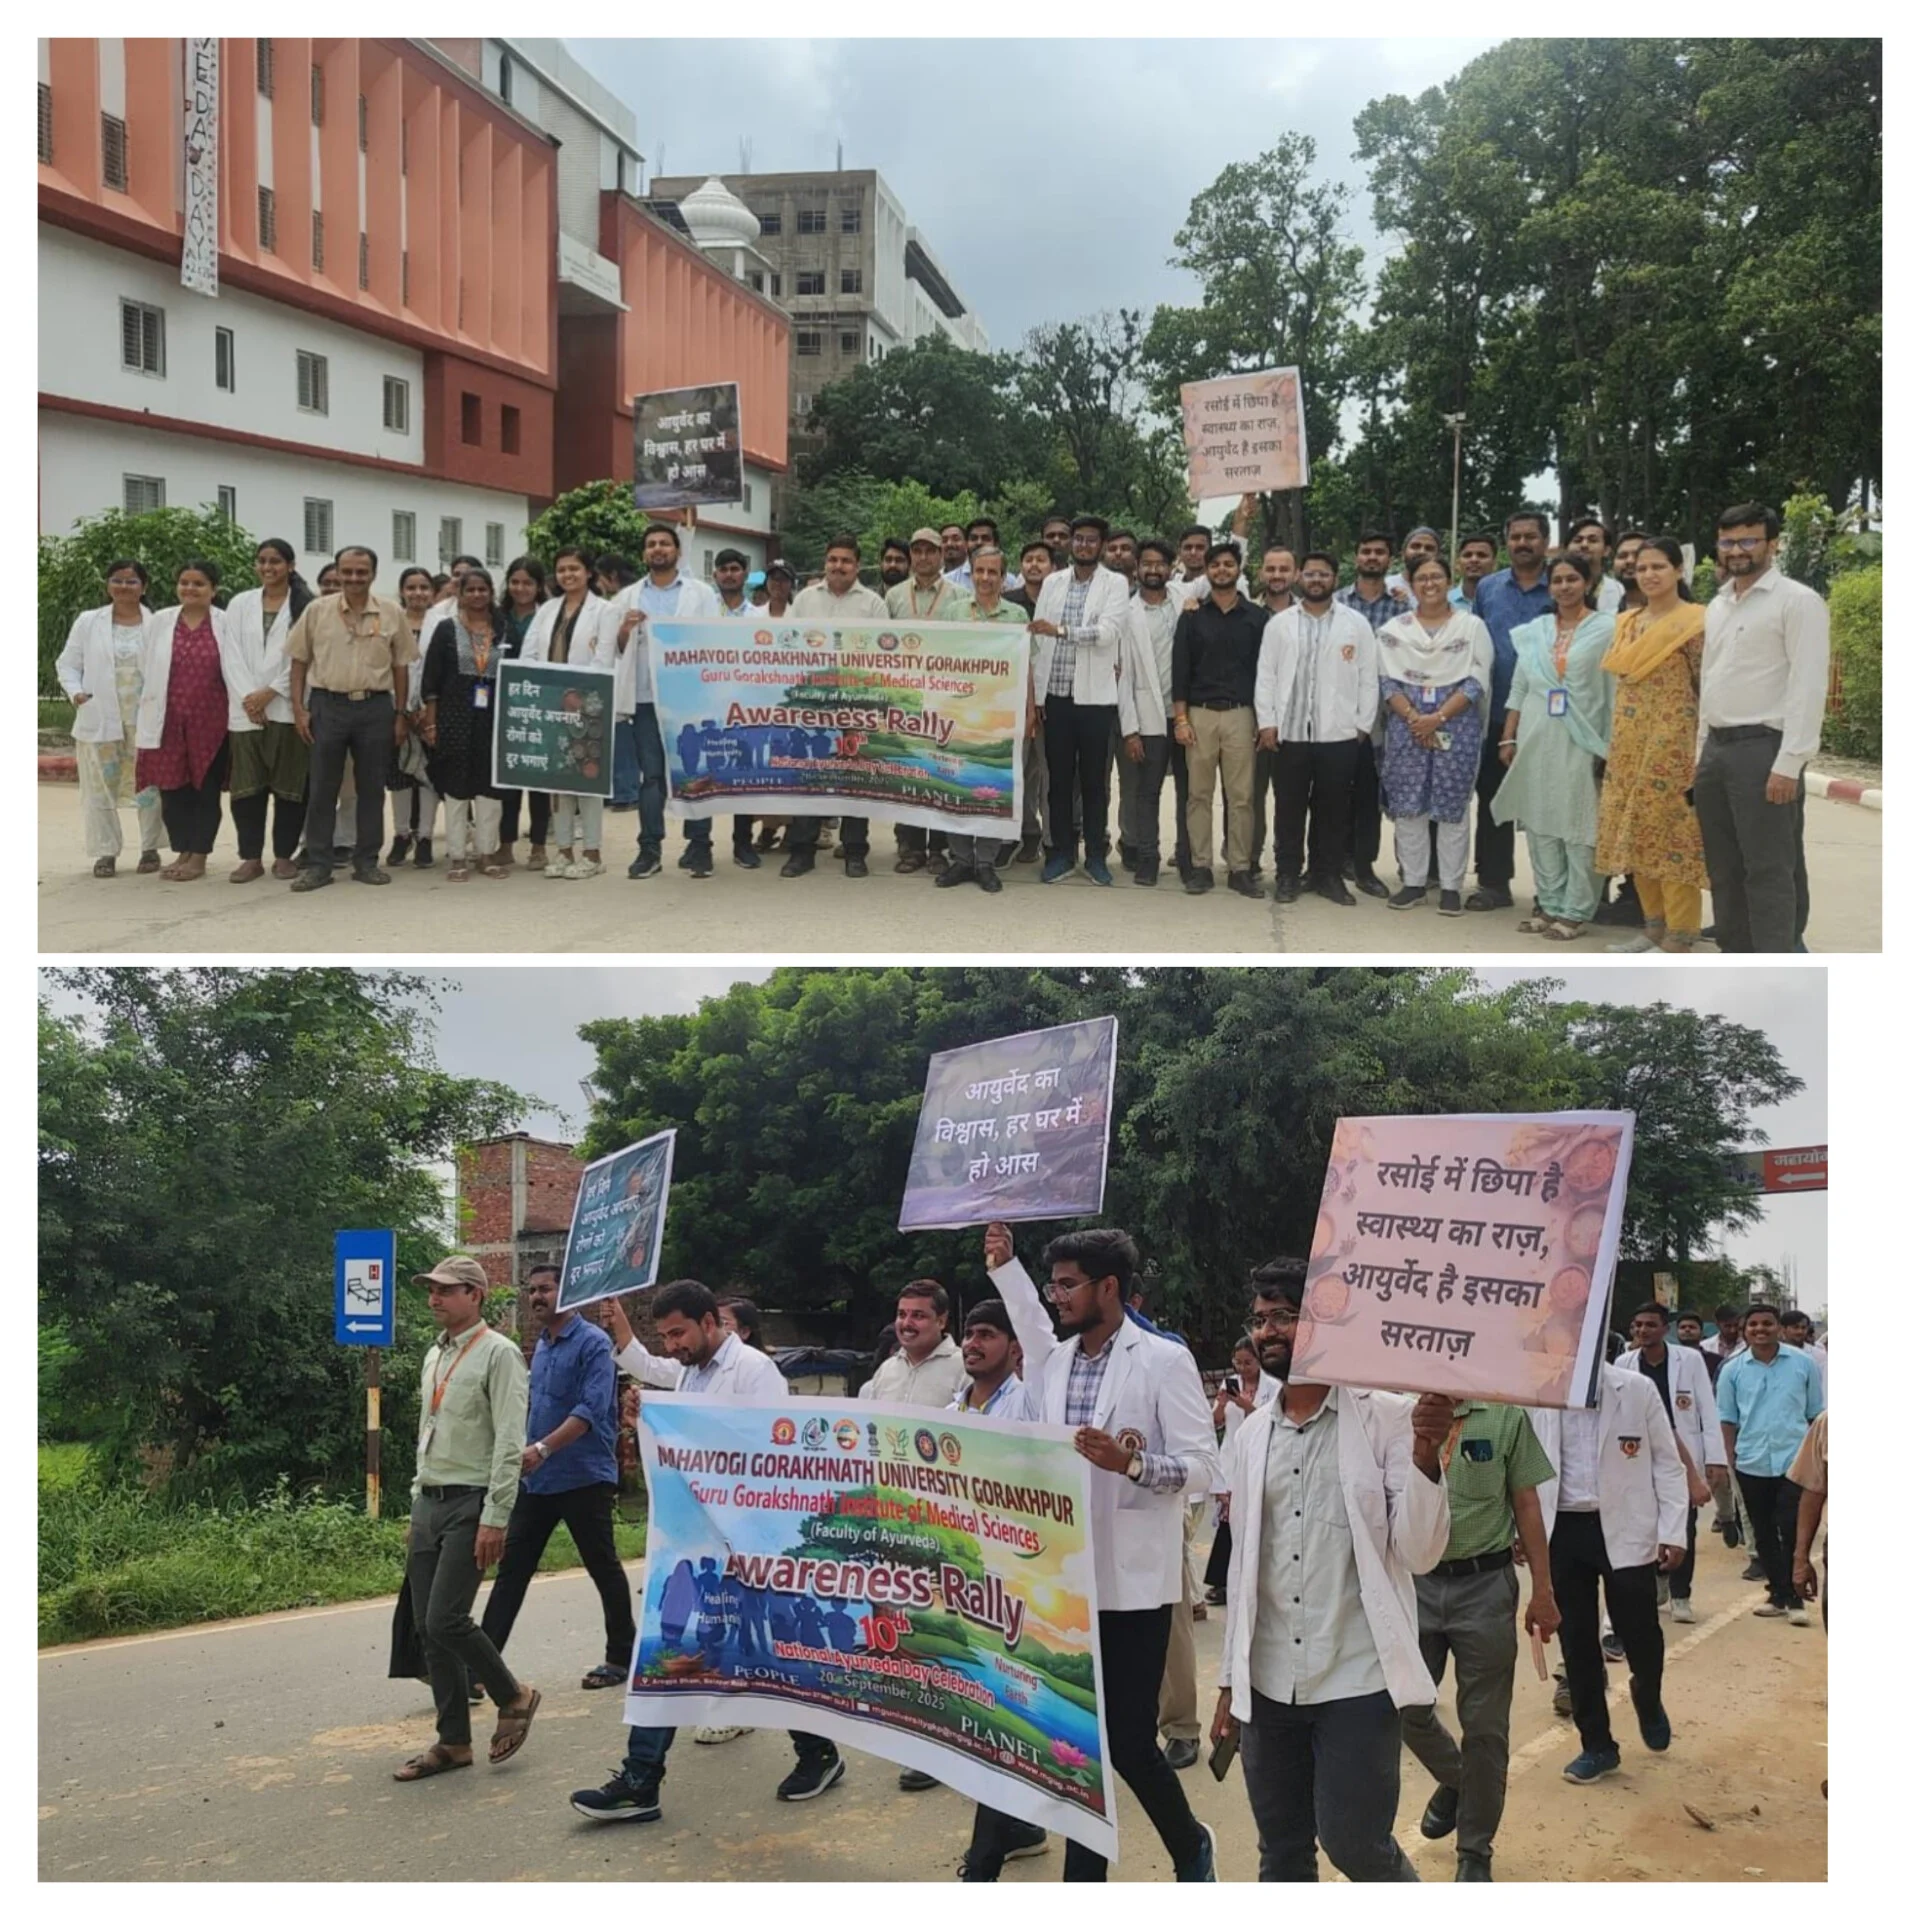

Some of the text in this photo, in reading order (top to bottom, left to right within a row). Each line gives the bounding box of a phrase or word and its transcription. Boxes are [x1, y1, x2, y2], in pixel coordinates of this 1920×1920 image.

[1204, 395, 1229, 412] रसोई
[1233, 394, 1242, 409] में
[1271, 392, 1280, 409] है
[684, 439, 698, 455] हर
[1241, 440, 1250, 455] है
[664, 649, 1009, 676] MAHAYOGI GORAKHNATH UNIVERSITY GORAKHPUR
[701, 669, 731, 683] Guru
[733, 669, 806, 685] Gorakshnath
[880, 673, 925, 689] Medical
[929, 675, 975, 694] Sciences
[508, 682, 520, 697] हर
[726, 702, 954, 744] Awareness Rally
[965, 1067, 1061, 1104] आयुर्वेद का
[934, 1097, 1083, 1145] विश्वास, हर घर में
[968, 1151, 1040, 1183] हो आस
[1377, 1155, 1564, 1202] रसोई में छिपा है
[1356, 1211, 1550, 1259] स्वास्थ्य का राज़,
[1342, 1259, 1545, 1309] आयुर्वेद है इसका
[1380, 1320, 1475, 1361] सरताज़
[751, 1452, 874, 1484] GORAKHNATH
[878, 1461, 969, 1500] UNIVERSITY
[971, 1476, 1075, 1526] GORAKHPUR
[688, 1480, 1040, 1551] Guru Gorakshnath Institute of Medical Sciences
[811, 1522, 940, 1551] (Faculty of Ayurveda)
[941, 1562, 1024, 1643] Rally
[859, 1608, 913, 1652] 10th
[734, 1664, 800, 1687] PEOPLE
[773, 1640, 995, 1710] National Ayurveda Day Celebration
[844, 1675, 914, 1702] September,
[917, 1691, 945, 1710] 2025
[994, 1656, 1038, 1690] Nurturing
[961, 1715, 1041, 1765] PLANET
